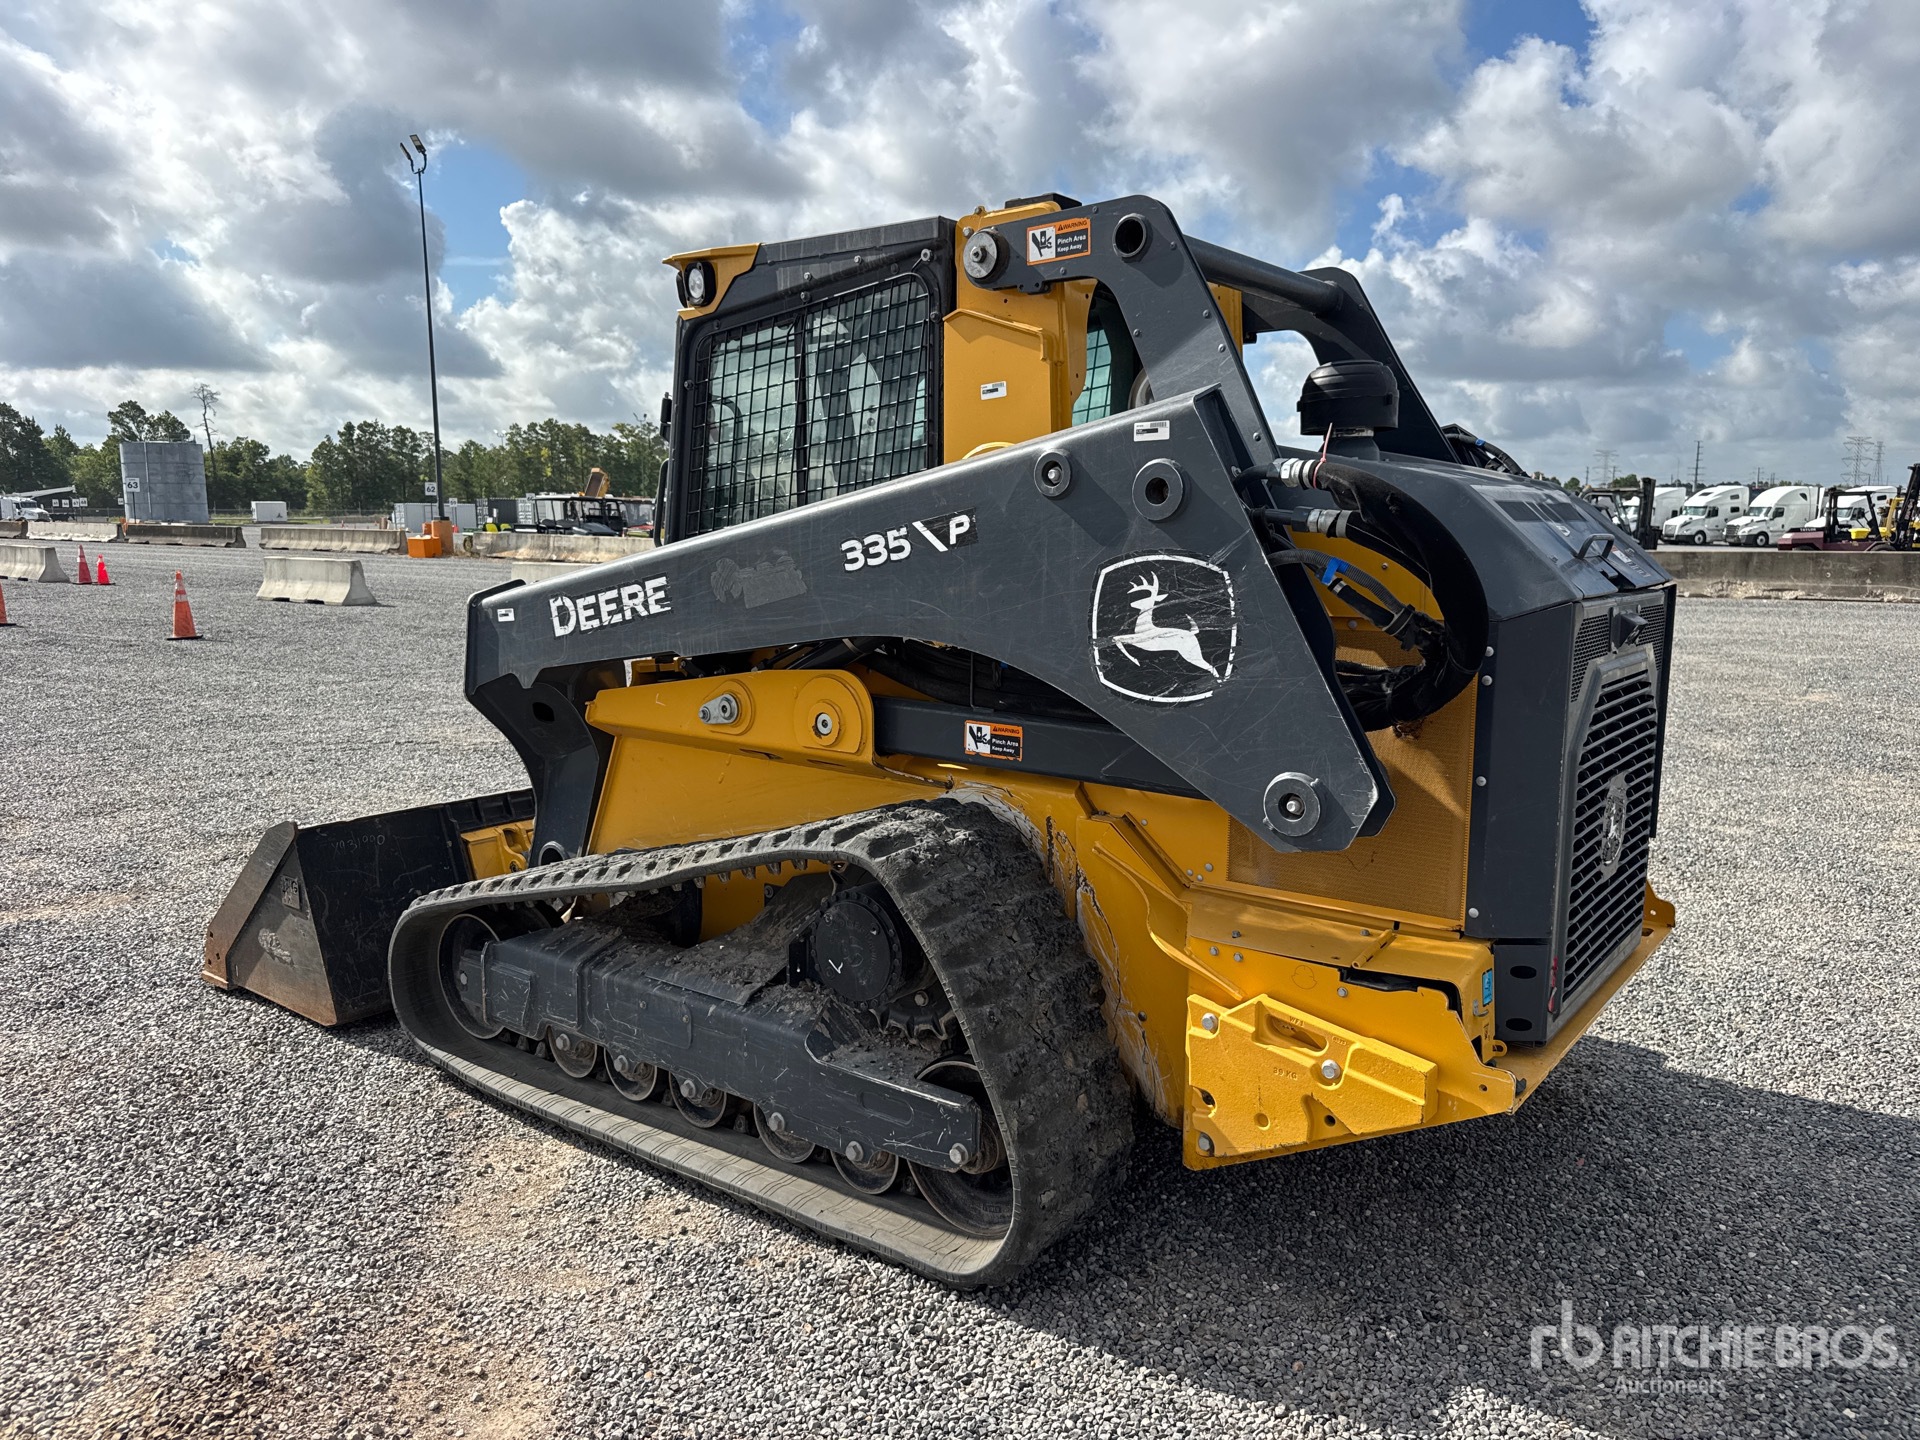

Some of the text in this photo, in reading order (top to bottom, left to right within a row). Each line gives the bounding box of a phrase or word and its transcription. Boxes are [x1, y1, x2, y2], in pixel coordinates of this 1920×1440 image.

[1062, 220, 1087, 230] WARNING
[1057, 234, 1087, 245] Pinch Area
[127, 481, 138, 489] 63
[840, 526, 911, 572] 335
[549, 576, 671, 637] DEERE
[996, 727, 1019, 735] WARNING
